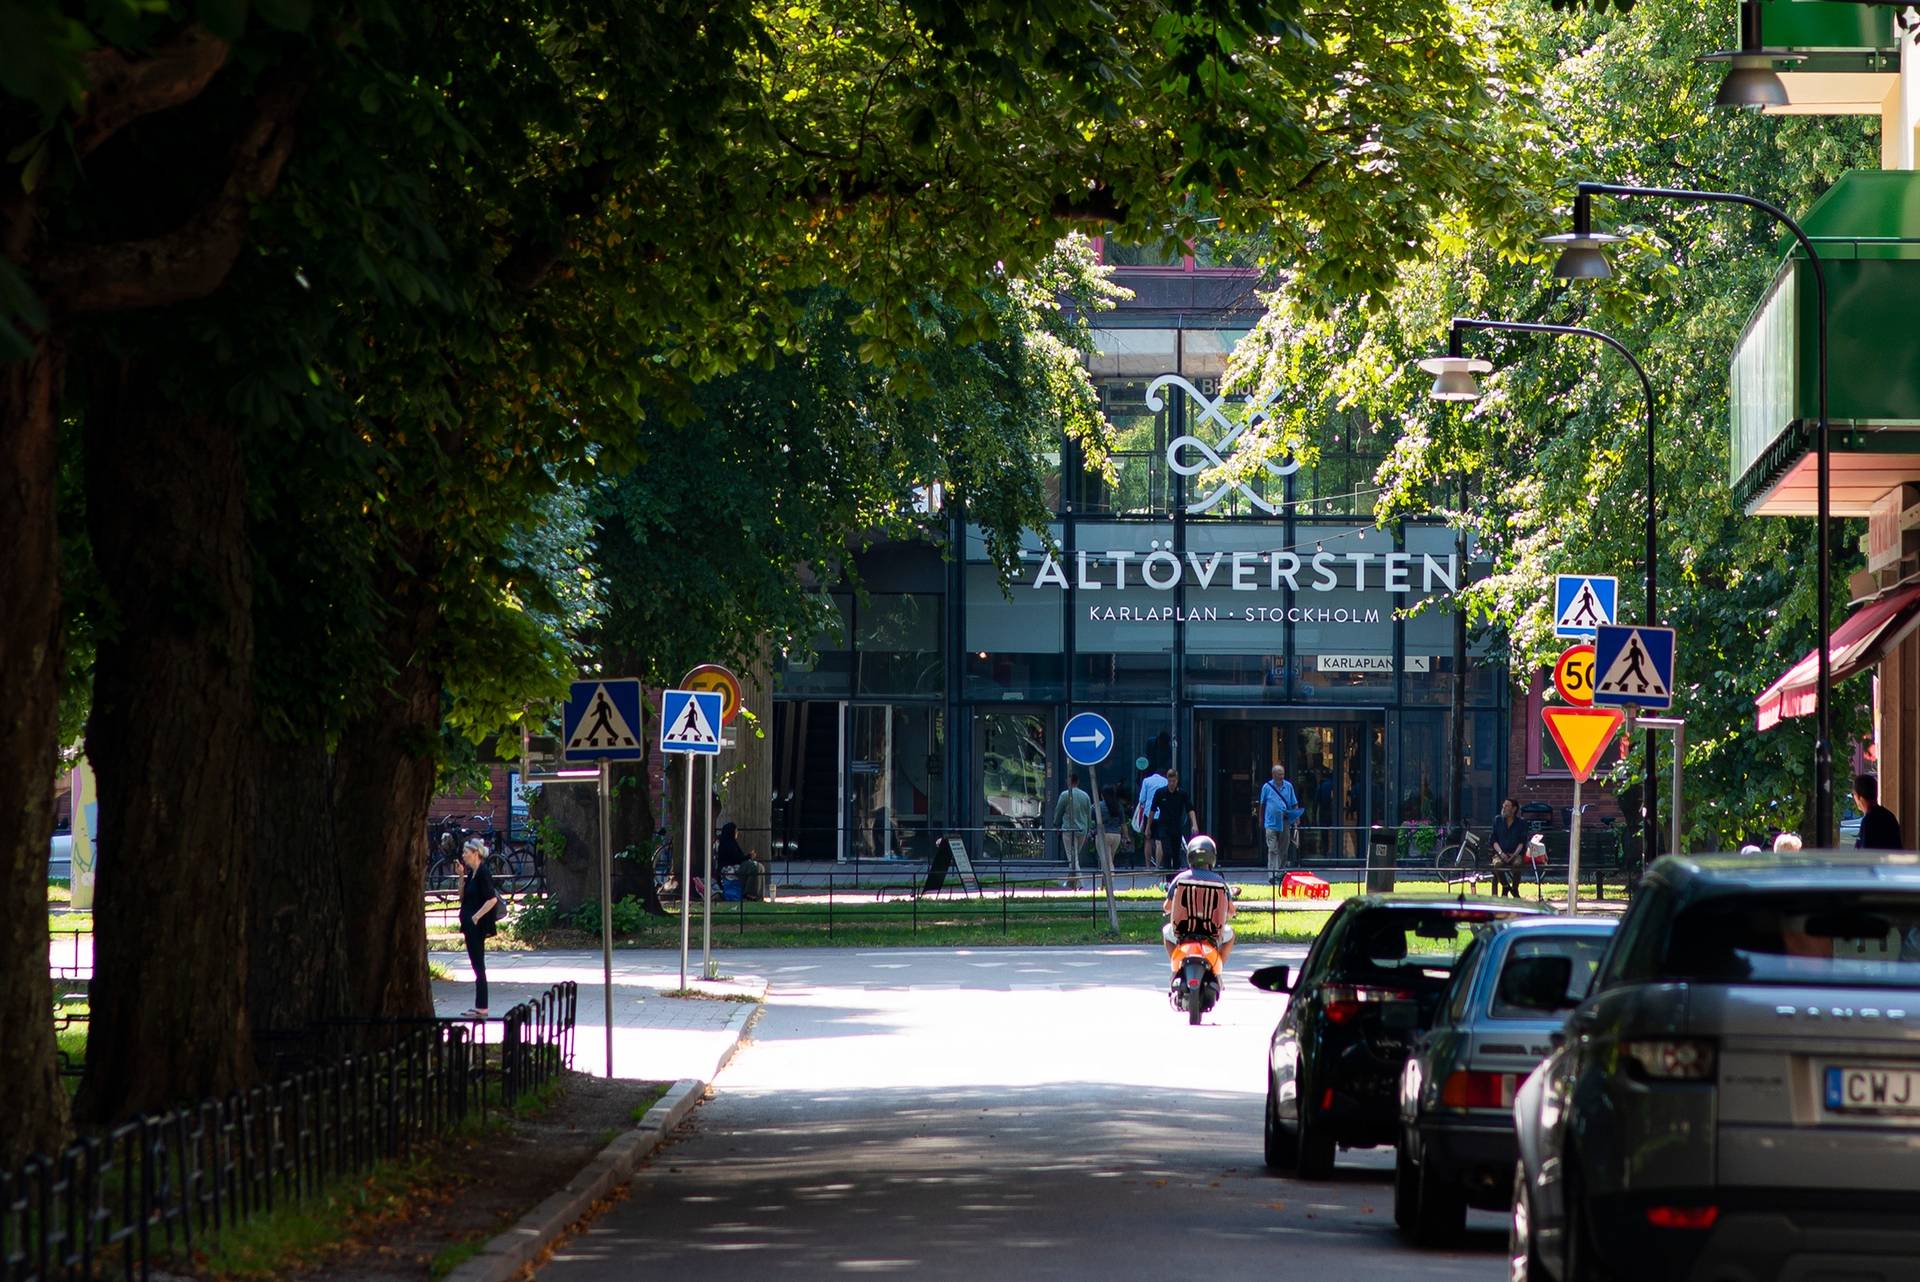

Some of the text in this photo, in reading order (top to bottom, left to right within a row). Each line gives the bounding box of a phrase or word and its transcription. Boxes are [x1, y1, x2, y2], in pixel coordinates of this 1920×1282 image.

[1090, 606, 1379, 623] KARLAPLAN STOCKHOLM
[1323, 657, 1393, 672] KARLAPLAN
[1848, 1073, 1911, 1104] CWJ
